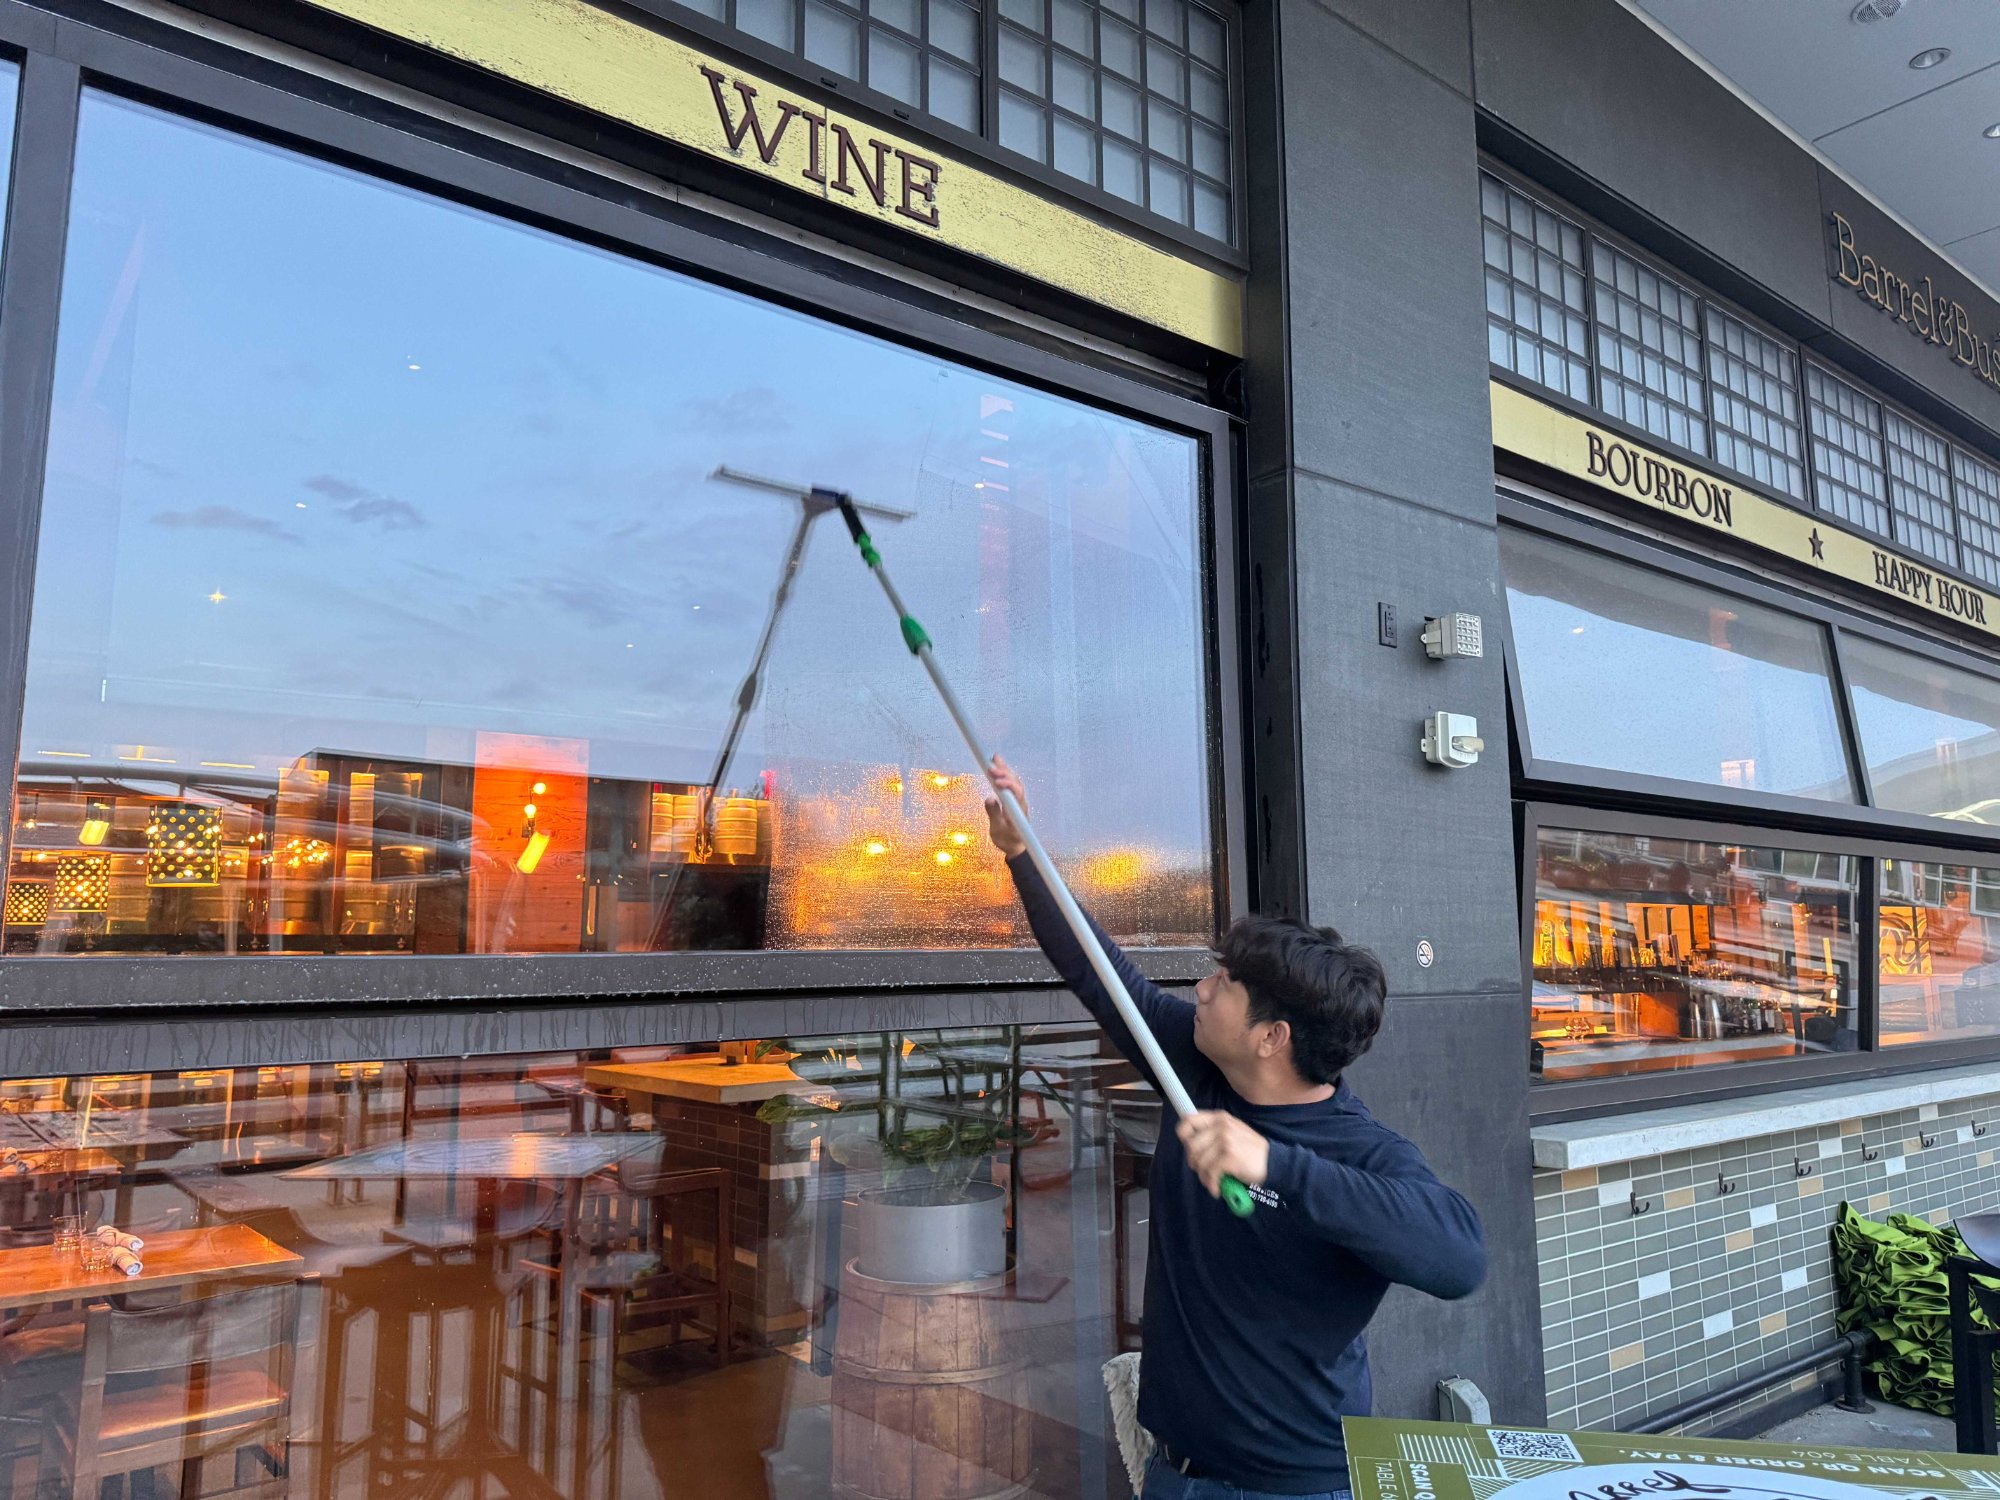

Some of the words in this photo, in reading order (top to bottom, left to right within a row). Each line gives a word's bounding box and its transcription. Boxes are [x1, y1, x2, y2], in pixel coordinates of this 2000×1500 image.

[701, 65, 940, 227] WINE
[1586, 431, 1732, 528] BOURBON
[1872, 550, 1933, 604] HAPPY
[1936, 578, 1987, 625] HOUR
[1688, 1454, 1706, 1462] &
[1792, 1450, 1836, 1460] 604
[1845, 1453, 1931, 1466] TABLE
[1716, 1456, 1806, 1469] ORDER
[1812, 1462, 1860, 1472] QR.
[1375, 1461, 1398, 1490] TABLE
[1410, 1463, 1434, 1490] SCAN
[1867, 1465, 1946, 1478] SCAN
